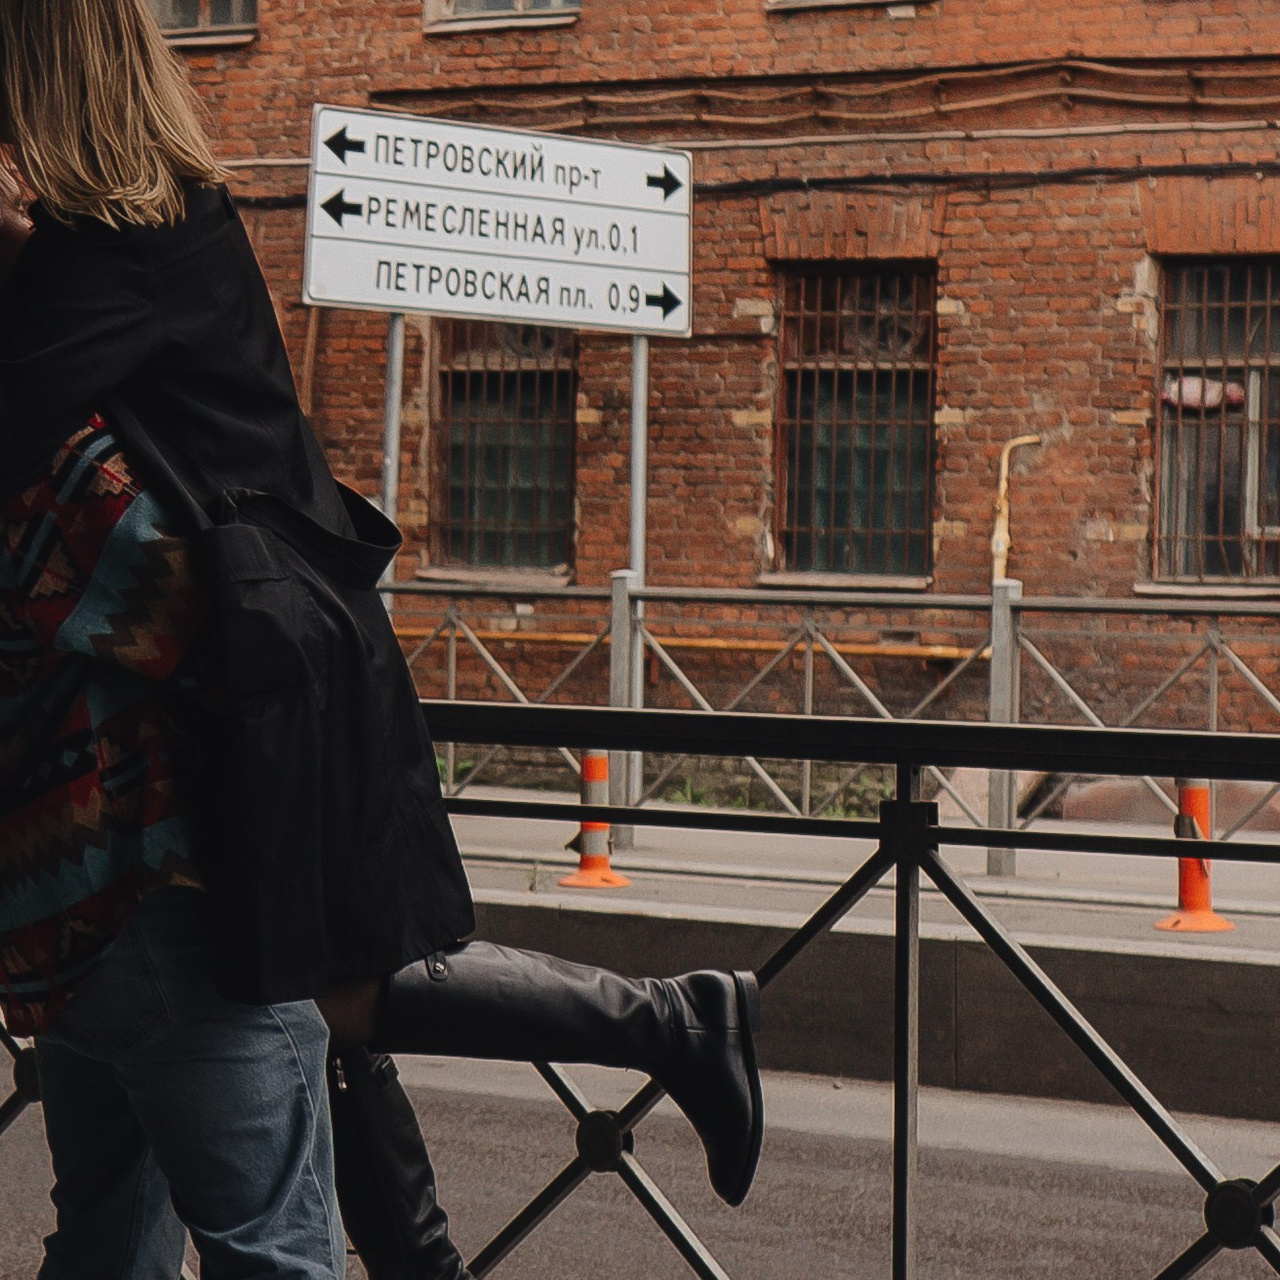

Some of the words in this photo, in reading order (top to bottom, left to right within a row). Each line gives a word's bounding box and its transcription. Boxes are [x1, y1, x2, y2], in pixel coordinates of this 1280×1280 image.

[374, 133, 545, 185] ПЕТРОВСКИЙ
[554, 163, 602, 195] пр-т
[366, 195, 566, 247] РЕМЕСЛЕННАЯ
[375, 260, 550, 306] ПЕТРОВСКАЯ
[559, 285, 594, 310] пл.
[607, 282, 640, 315] 0,9
